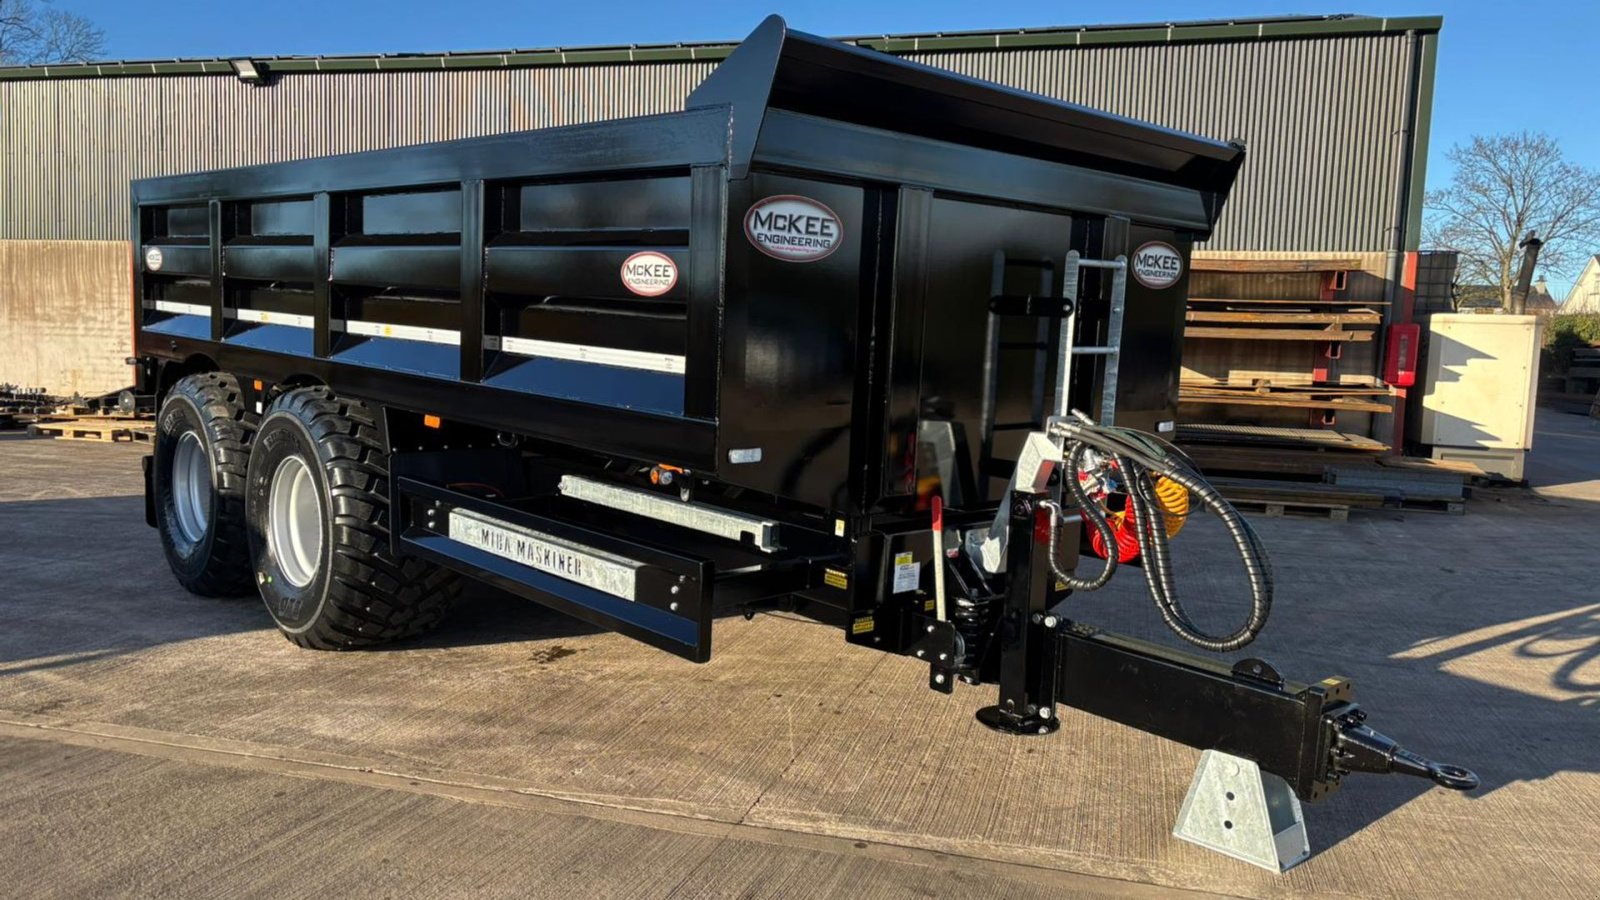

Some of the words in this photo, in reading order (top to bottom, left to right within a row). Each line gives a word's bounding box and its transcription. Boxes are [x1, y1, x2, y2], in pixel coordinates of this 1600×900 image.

[756, 233, 831, 249] ENGINEERING
[1137, 268, 1177, 279] ENGINEERING
[628, 277, 670, 286] ENGINEERING
[516, 540, 582, 577] MASKINER
